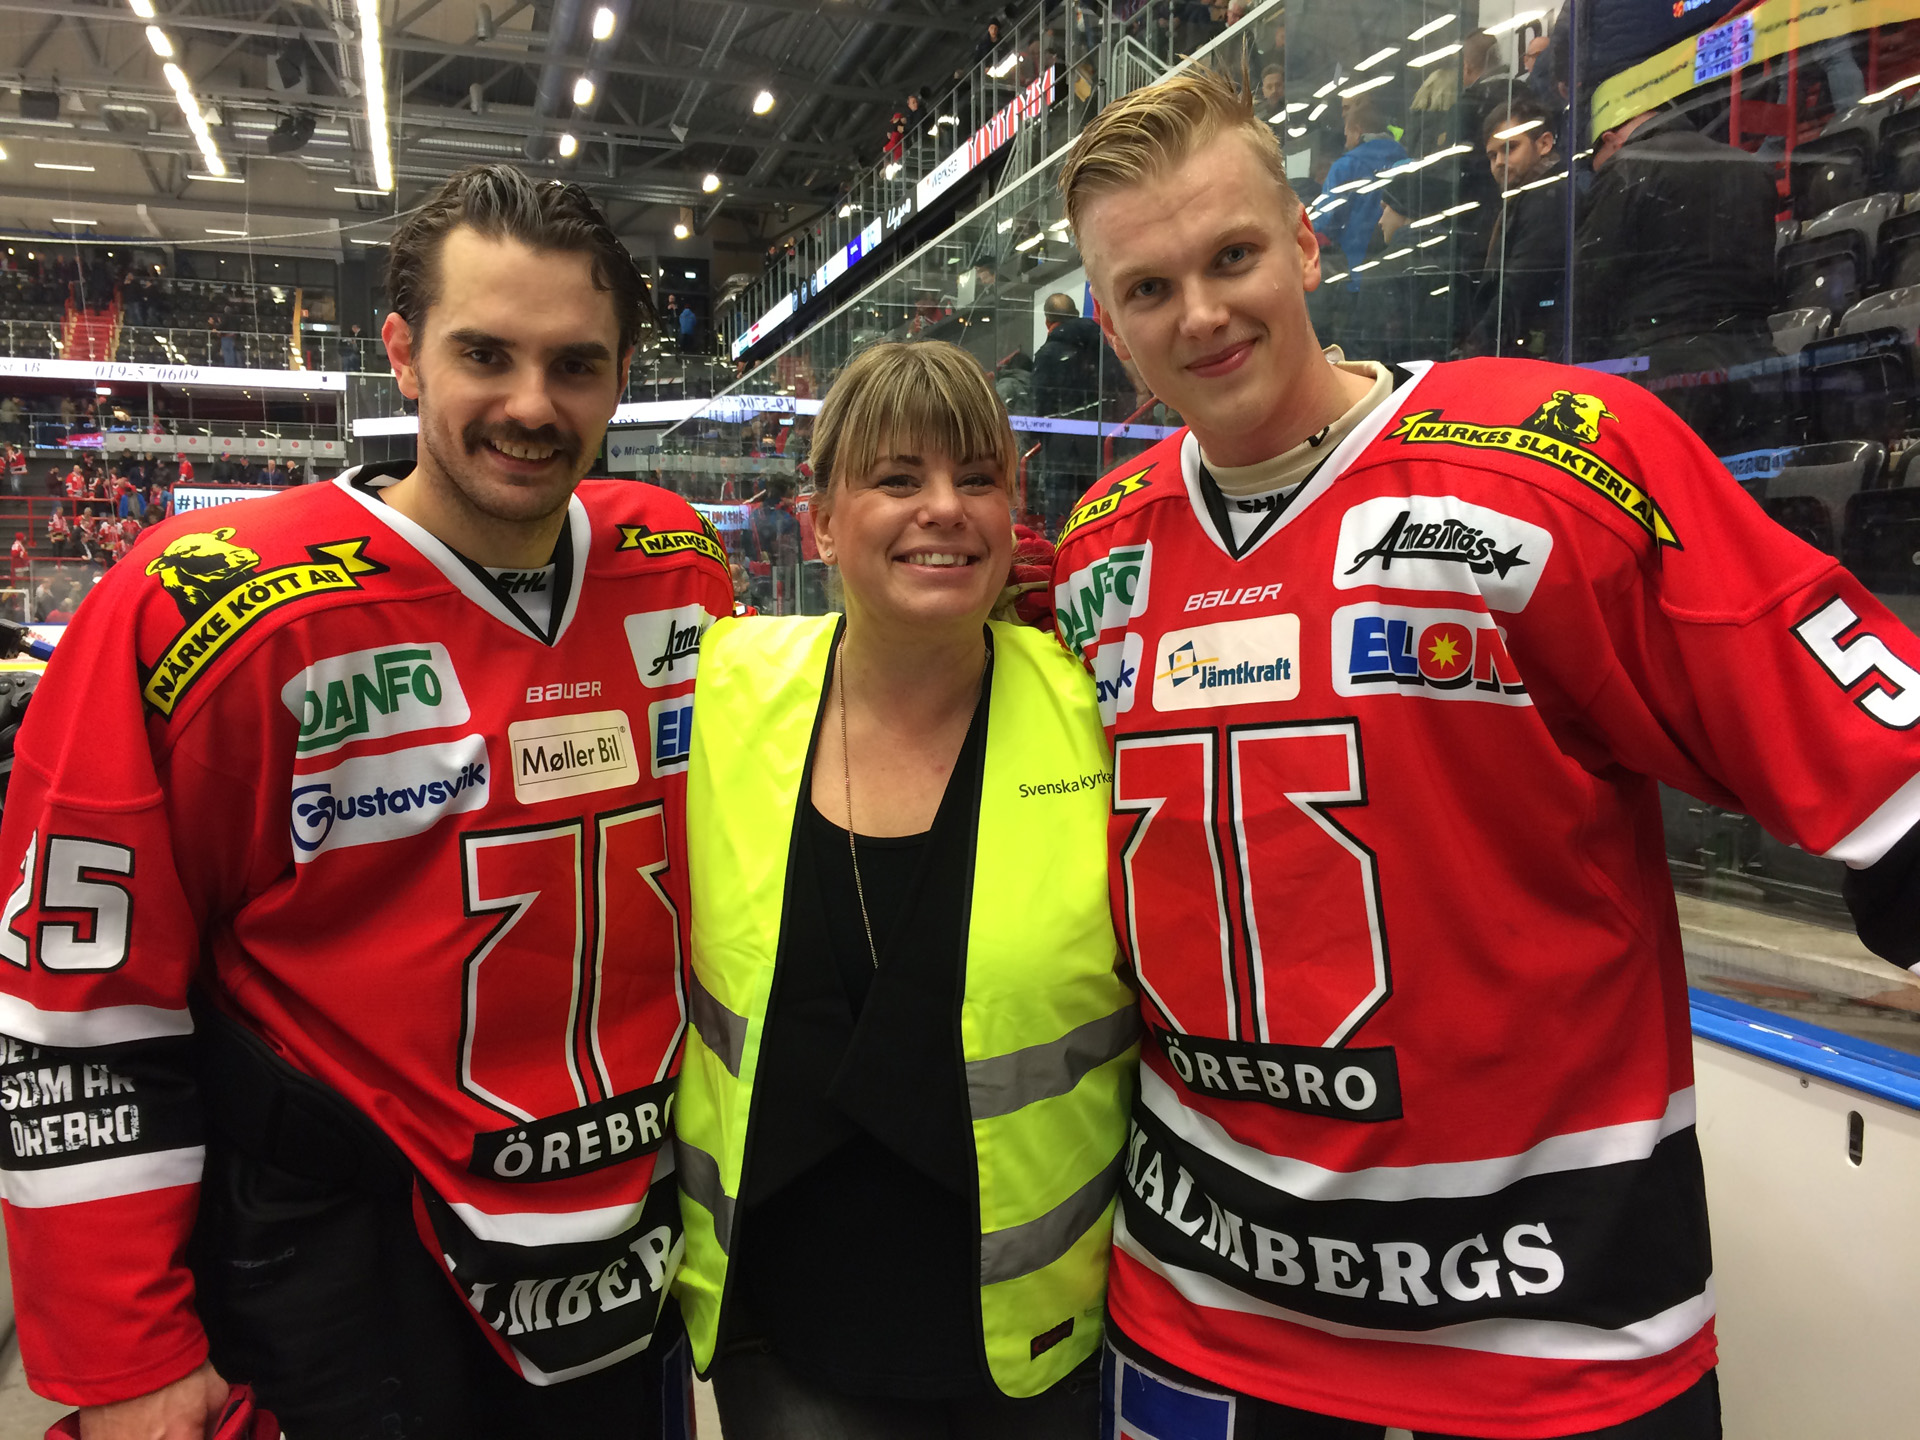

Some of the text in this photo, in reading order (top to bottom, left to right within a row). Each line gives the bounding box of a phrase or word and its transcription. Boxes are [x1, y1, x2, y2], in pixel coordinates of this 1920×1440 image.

[1413, 423, 1512, 445] NÄRKES
[1515, 434, 1632, 504] SLAKTERI
[1084, 498, 1113, 520] AB
[649, 535, 708, 552] NÄRKES
[497, 571, 547, 594] SHL
[153, 569, 343, 704] NÄRKE KÖTT AB
[1199, 657, 1291, 690] Jämtkraft
[297, 650, 442, 752] DANFO
[522, 734, 620, 776] Møller Bil
[1019, 769, 1113, 798] Svenska kyrka
[0, 1064, 73, 1110] SOM
[1166, 1035, 1377, 1111] ÖREBRO
[10, 1104, 140, 1157] ÖREBRO
[444, 1224, 672, 1336] LMBER
